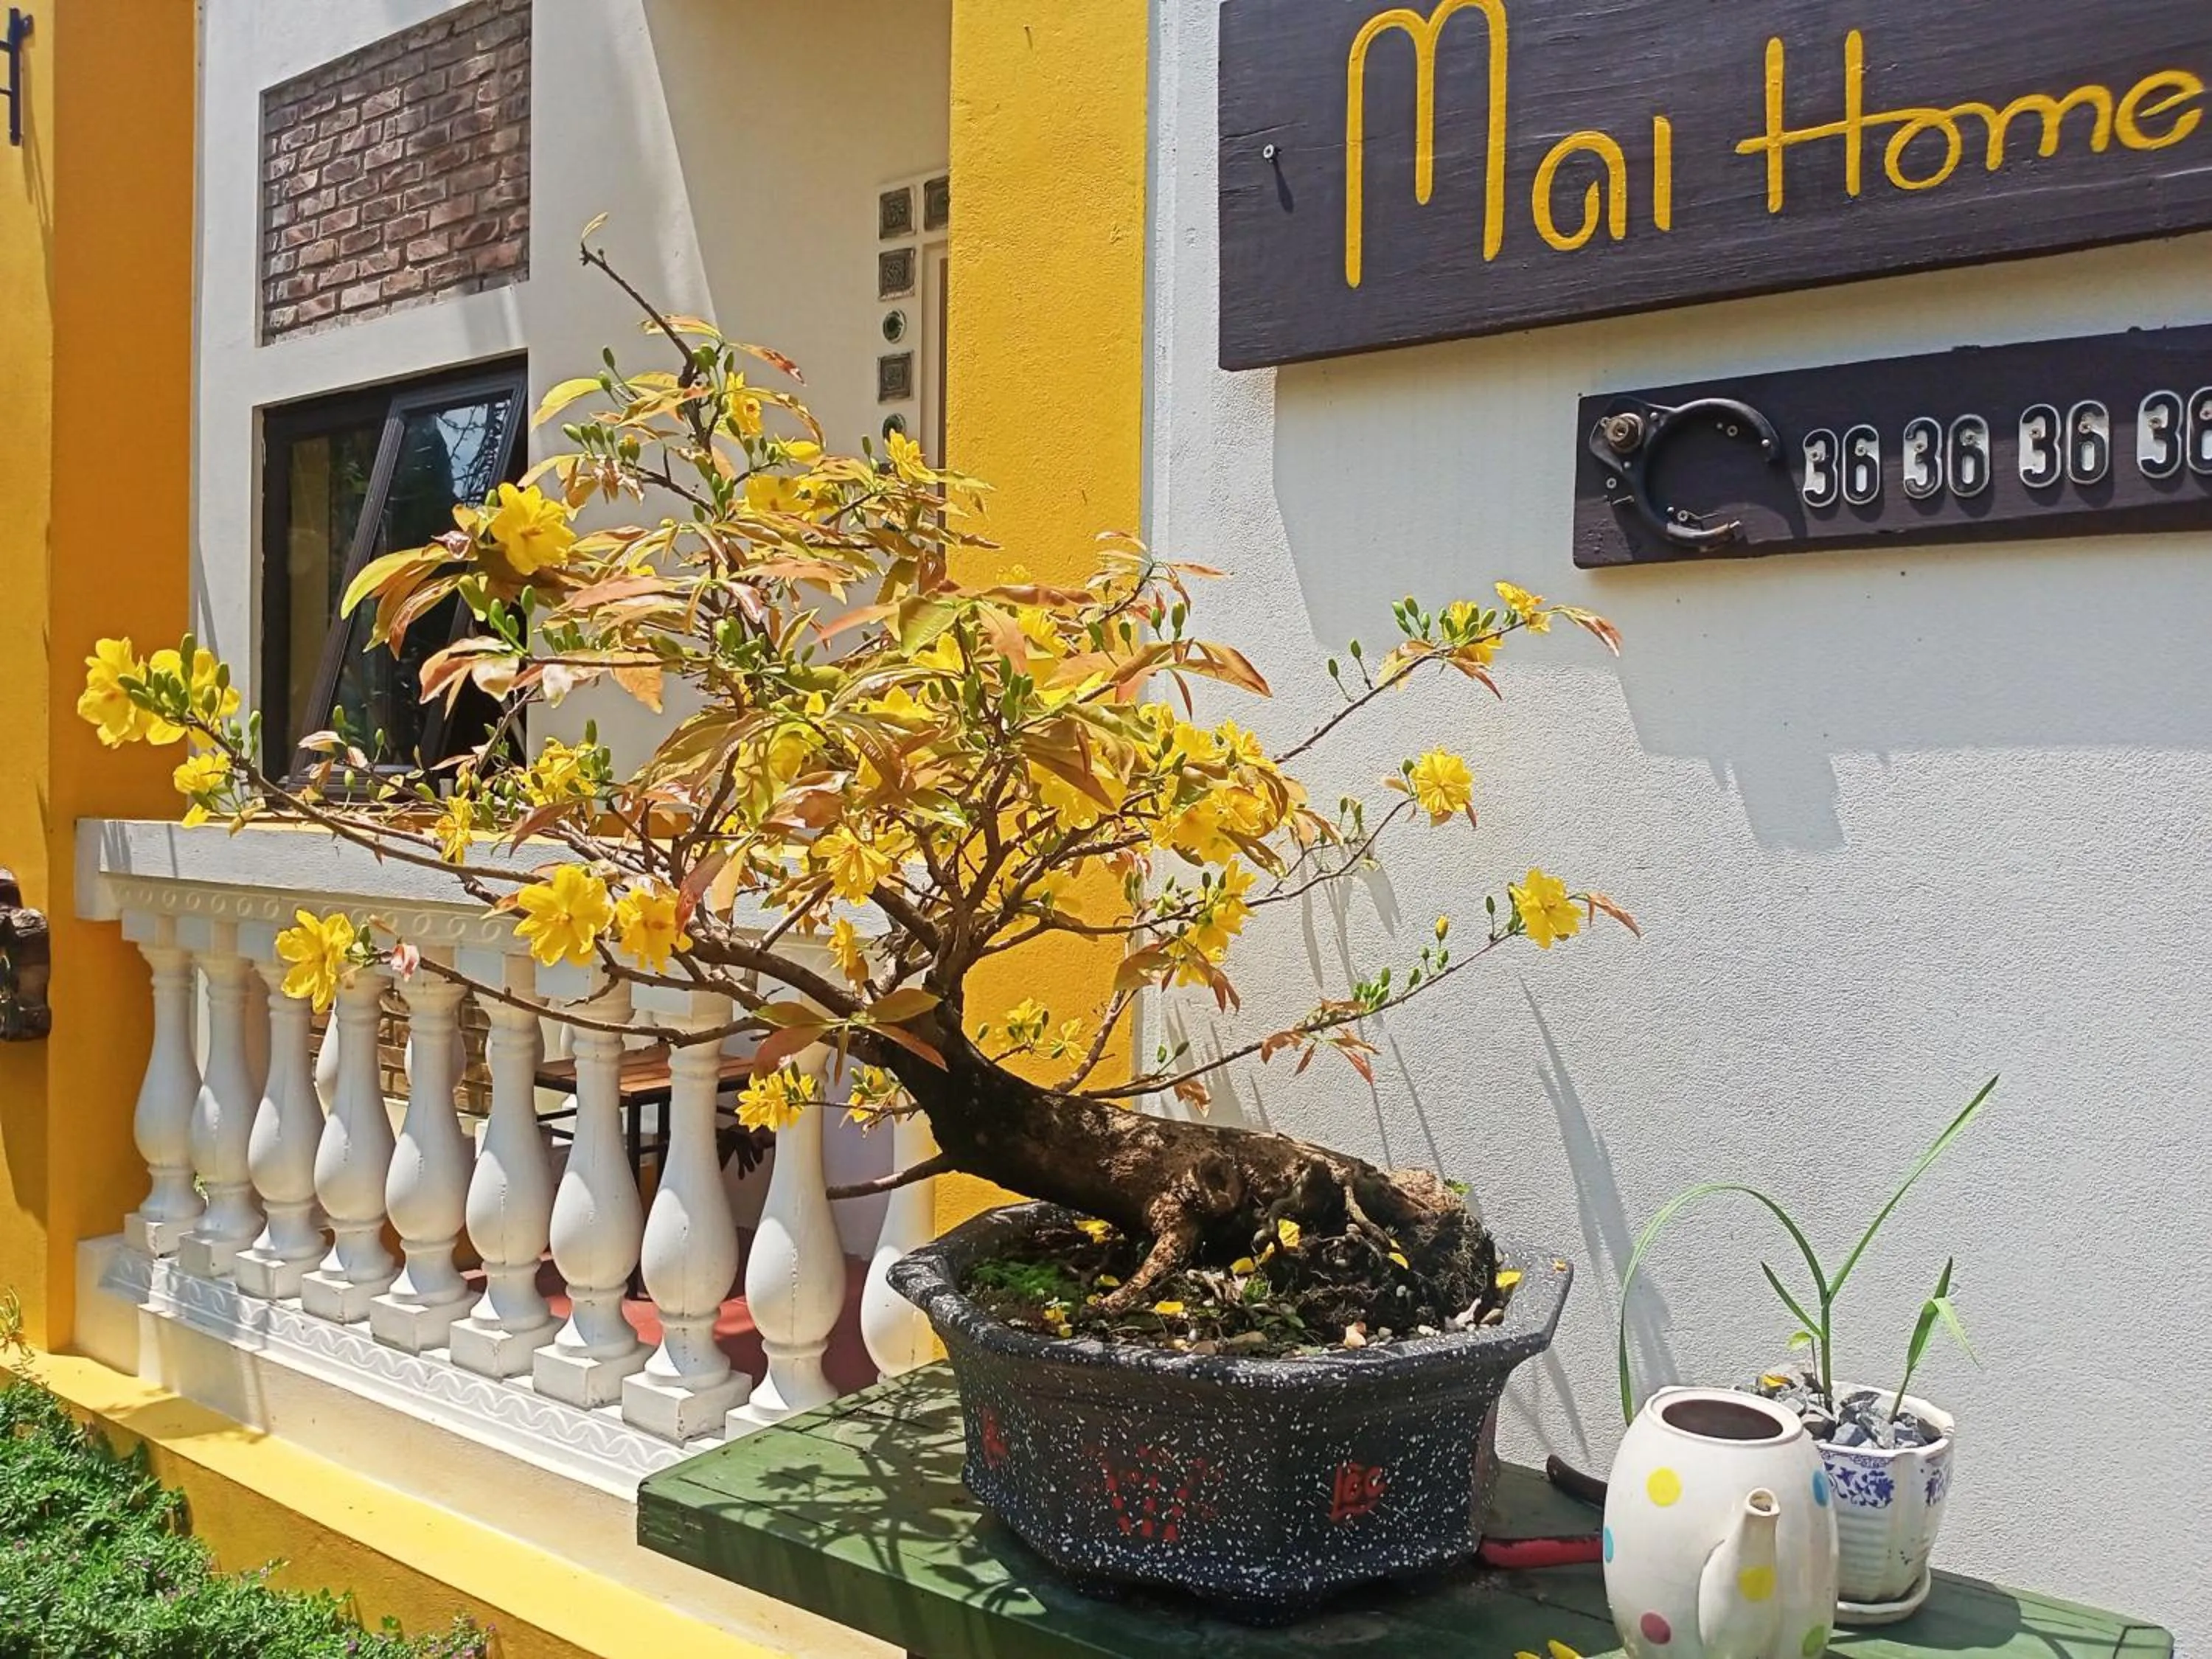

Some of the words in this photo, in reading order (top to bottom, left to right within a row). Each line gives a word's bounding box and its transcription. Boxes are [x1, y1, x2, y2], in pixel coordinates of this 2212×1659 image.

[1735, 29, 2204, 213] Home
[1803, 424, 1879, 507] 36
[1903, 414, 1989, 499] 36
[2019, 400, 2110, 488] 36
